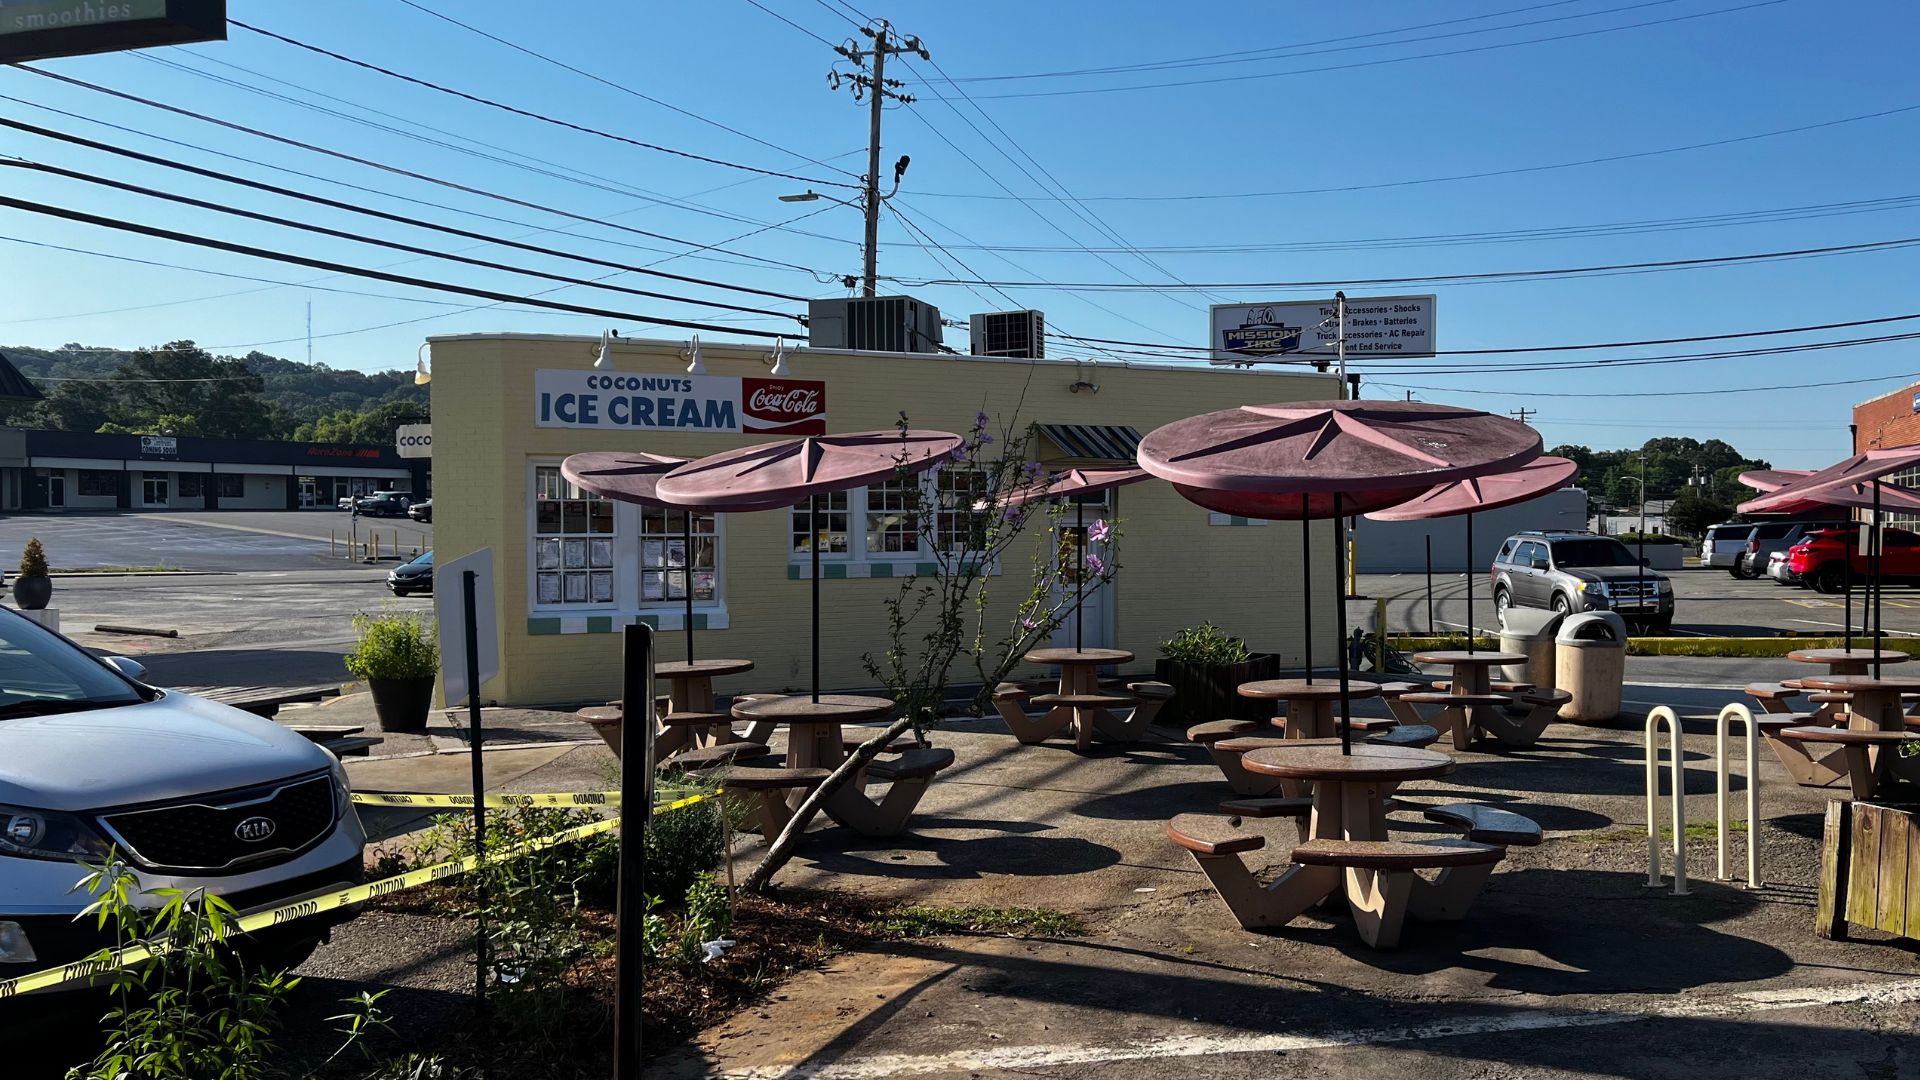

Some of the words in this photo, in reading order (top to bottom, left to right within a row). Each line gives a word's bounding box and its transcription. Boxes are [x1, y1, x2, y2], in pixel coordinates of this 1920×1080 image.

[15, 2, 131, 29] smoothies
[1393, 304, 1421, 313] Shocks
[1352, 319, 1378, 327] Brakes
[1383, 317, 1418, 326] Batteries
[1228, 329, 1297, 341] MISSION
[1317, 332, 1337, 340] Truck
[1343, 330, 1383, 339] ccessories
[1389, 329, 1400, 338] AC
[1401, 328, 1426, 338] Repair
[1359, 342, 1373, 351] End
[1374, 342, 1403, 351] Service
[586, 375, 693, 393] COCONUTS
[749, 388, 820, 414] Coca-Cola
[540, 392, 599, 424] ICE
[606, 396, 737, 430] CREAM
[242, 821, 271, 839] KIA
[273, 901, 317, 926] CUIDADO
[369, 876, 406, 898] CAUTION
